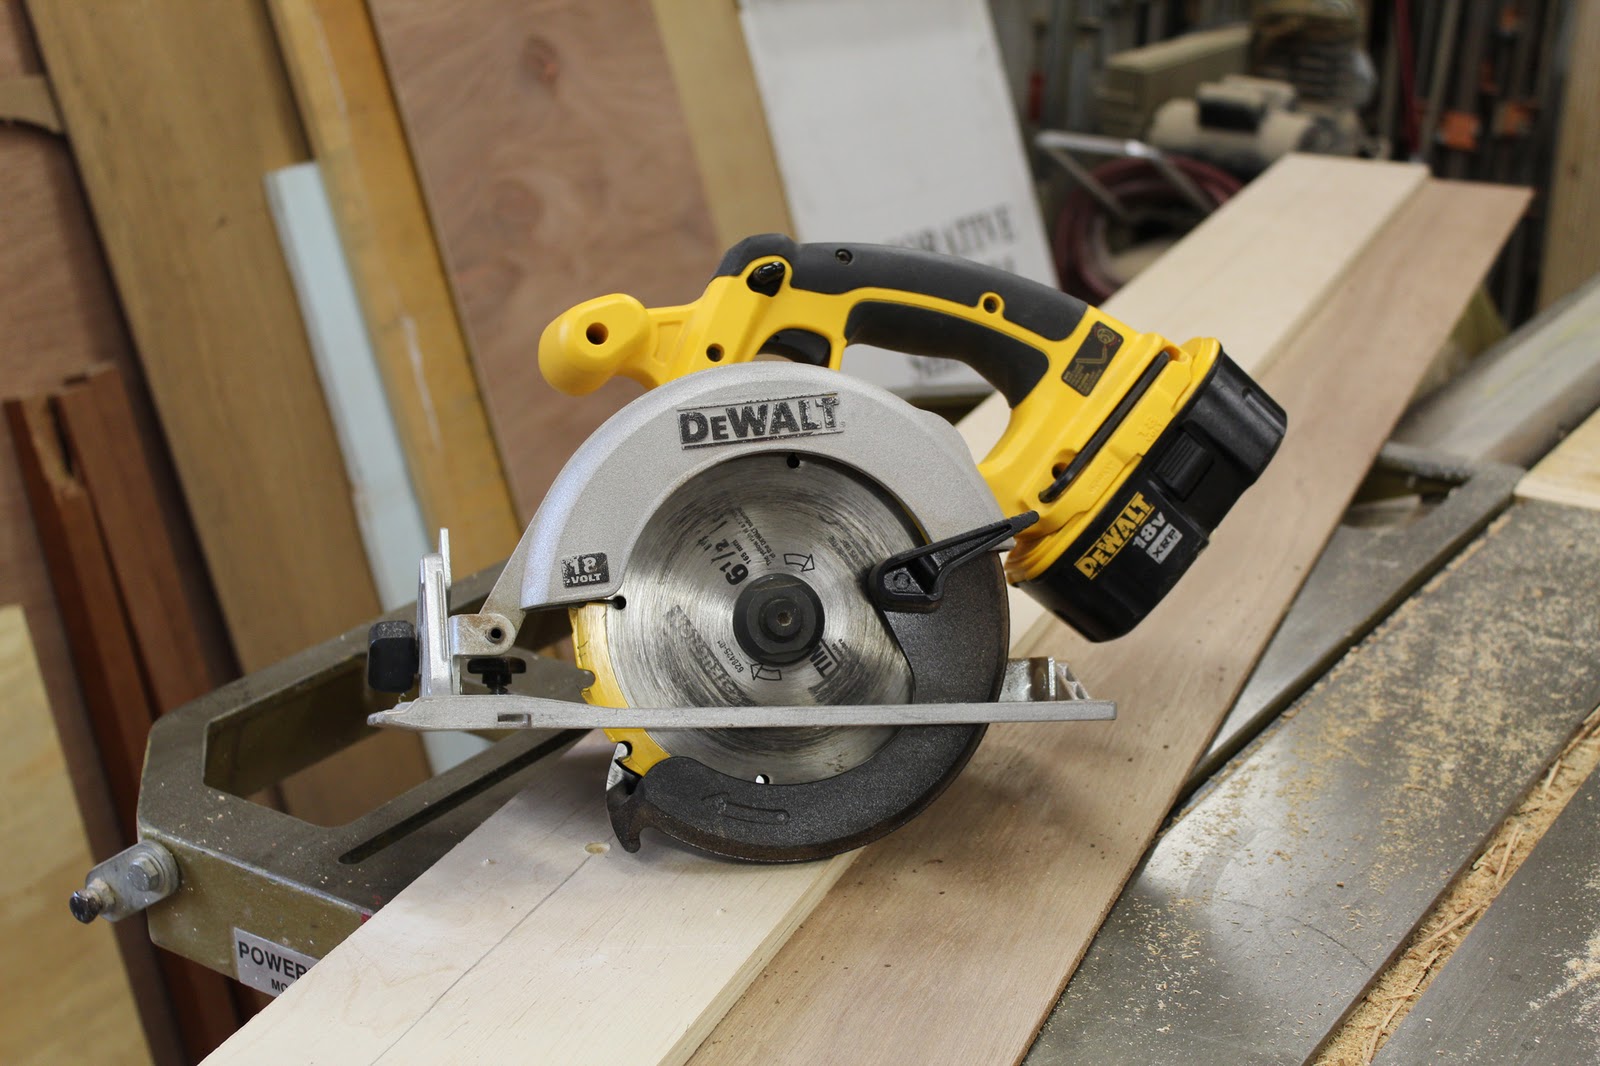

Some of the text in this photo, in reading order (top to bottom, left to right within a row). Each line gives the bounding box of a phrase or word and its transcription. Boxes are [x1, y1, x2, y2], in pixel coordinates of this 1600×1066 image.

[679, 396, 839, 445] DEWALT
[1075, 493, 1153, 579] DEWALT
[1131, 511, 1166, 549] 18V
[1152, 528, 1177, 558] XRP
[569, 556, 598, 575] 18
[740, 552, 752, 565] 165
[571, 573, 602, 584] VOLT
[238, 940, 311, 980] POWER
